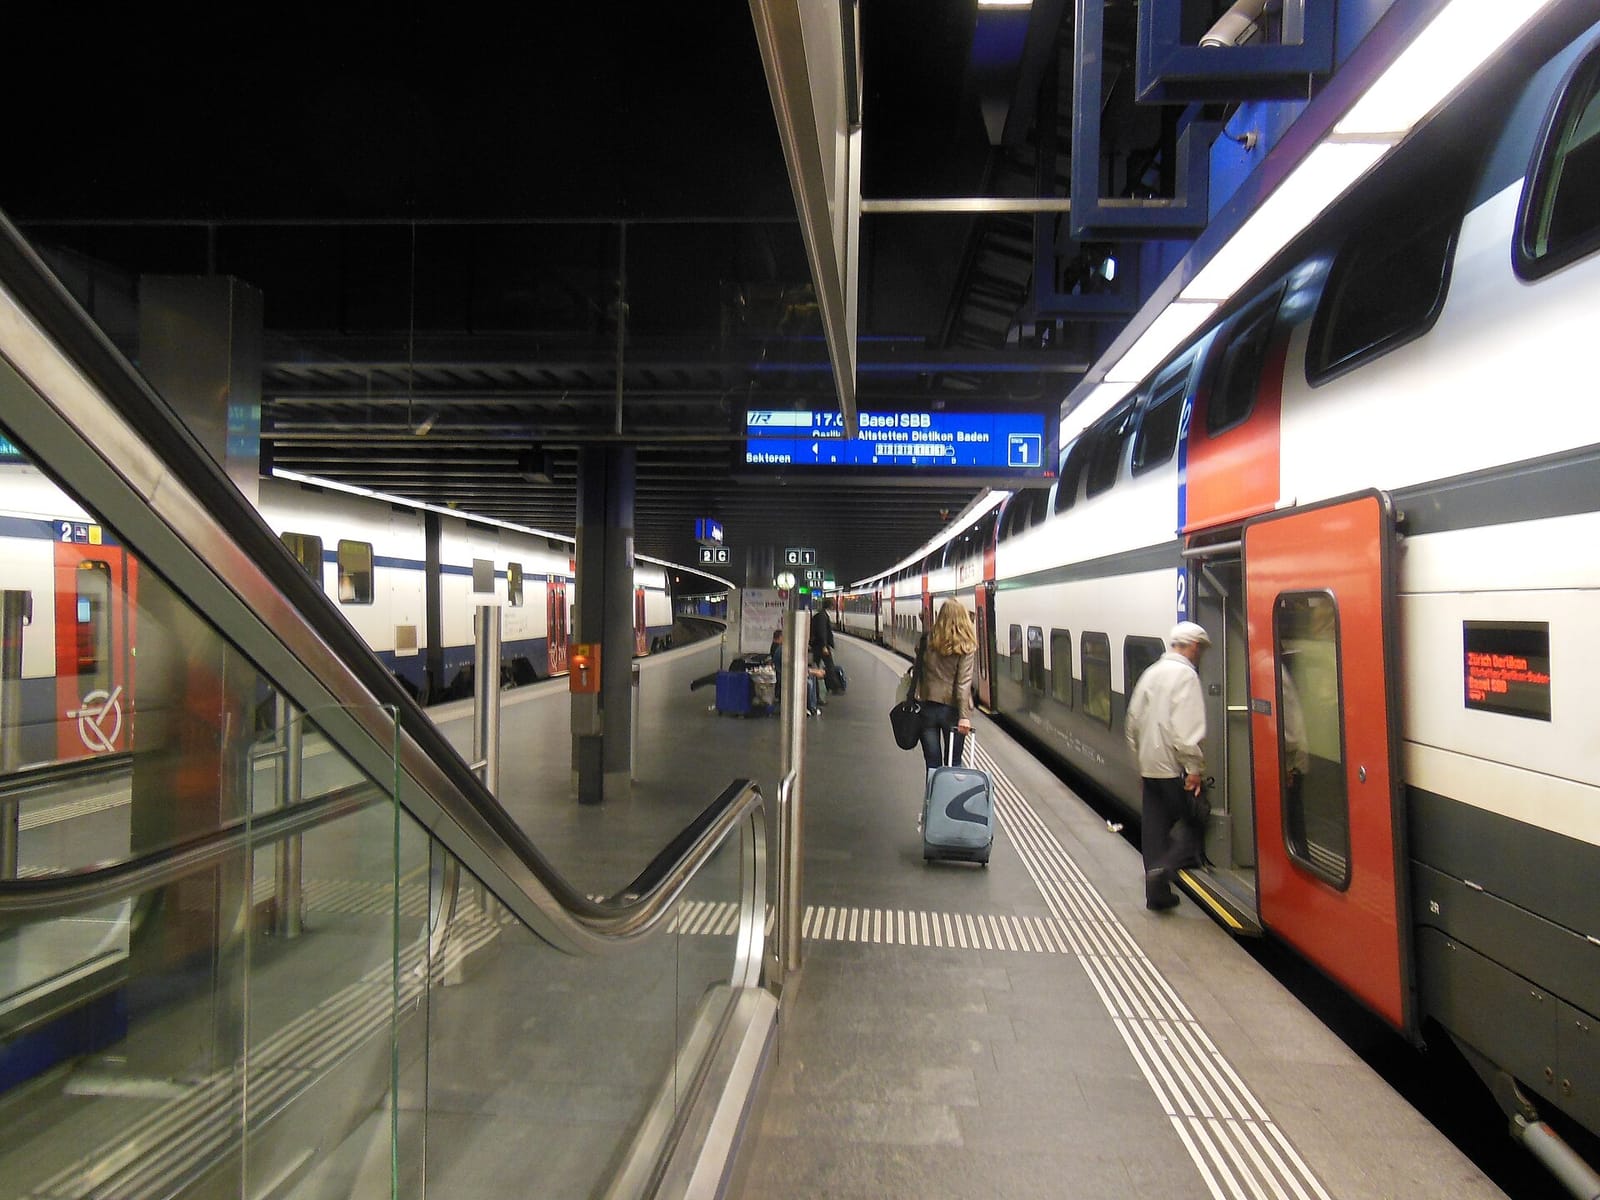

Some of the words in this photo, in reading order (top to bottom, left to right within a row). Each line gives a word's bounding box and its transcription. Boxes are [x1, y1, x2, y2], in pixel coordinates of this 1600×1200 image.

[815, 412, 845, 426] 17.0
[859, 413, 899, 428] Basel
[900, 413, 931, 428] SBB
[1180, 405, 1192, 440] 2
[911, 431, 954, 442] Dietikon
[956, 431, 990, 442] Baden
[1018, 442, 1028, 464] 1
[61, 522, 72, 542] 2
[1177, 575, 1186, 612] 2
